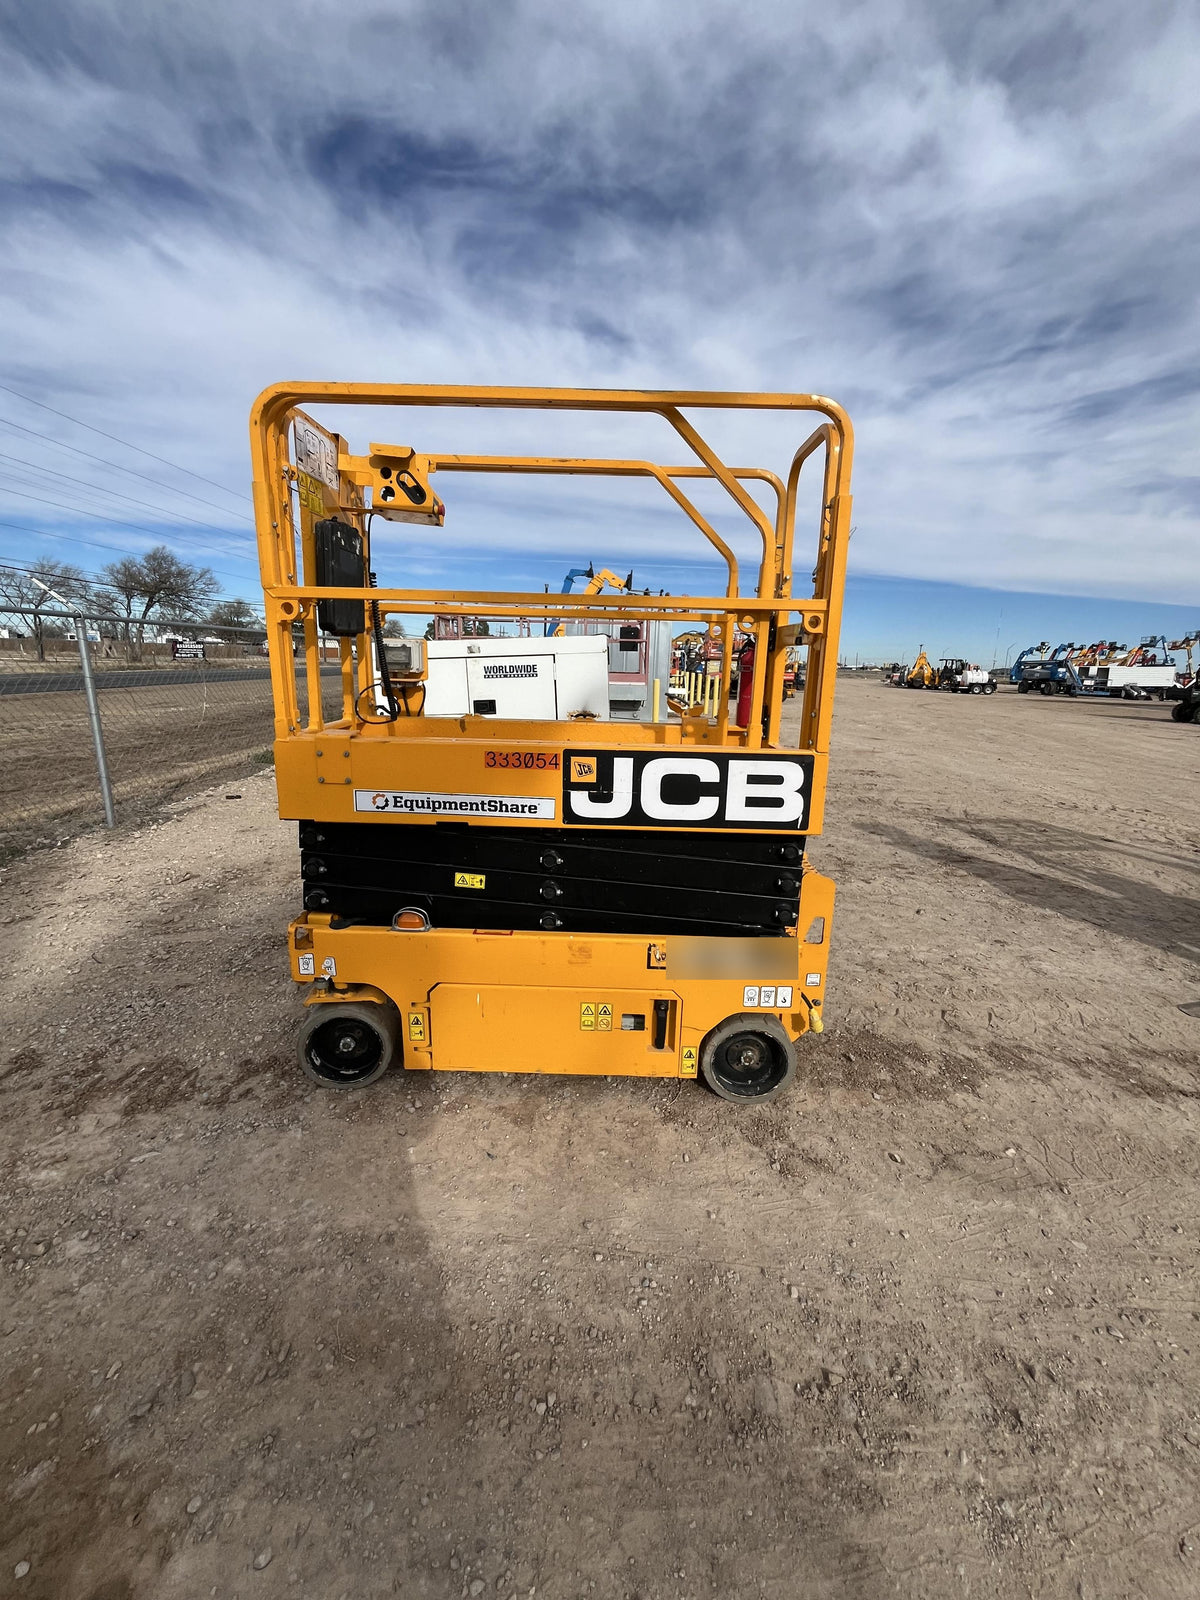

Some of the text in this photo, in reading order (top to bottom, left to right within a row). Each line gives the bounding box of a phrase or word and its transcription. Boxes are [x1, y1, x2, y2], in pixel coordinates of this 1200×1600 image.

[483, 664, 538, 674] WORLDWIDE
[486, 751, 560, 769] 333054
[576, 762, 593, 776] JCB
[570, 757, 805, 822] JCB
[393, 796, 538, 815] EquipmentShare
